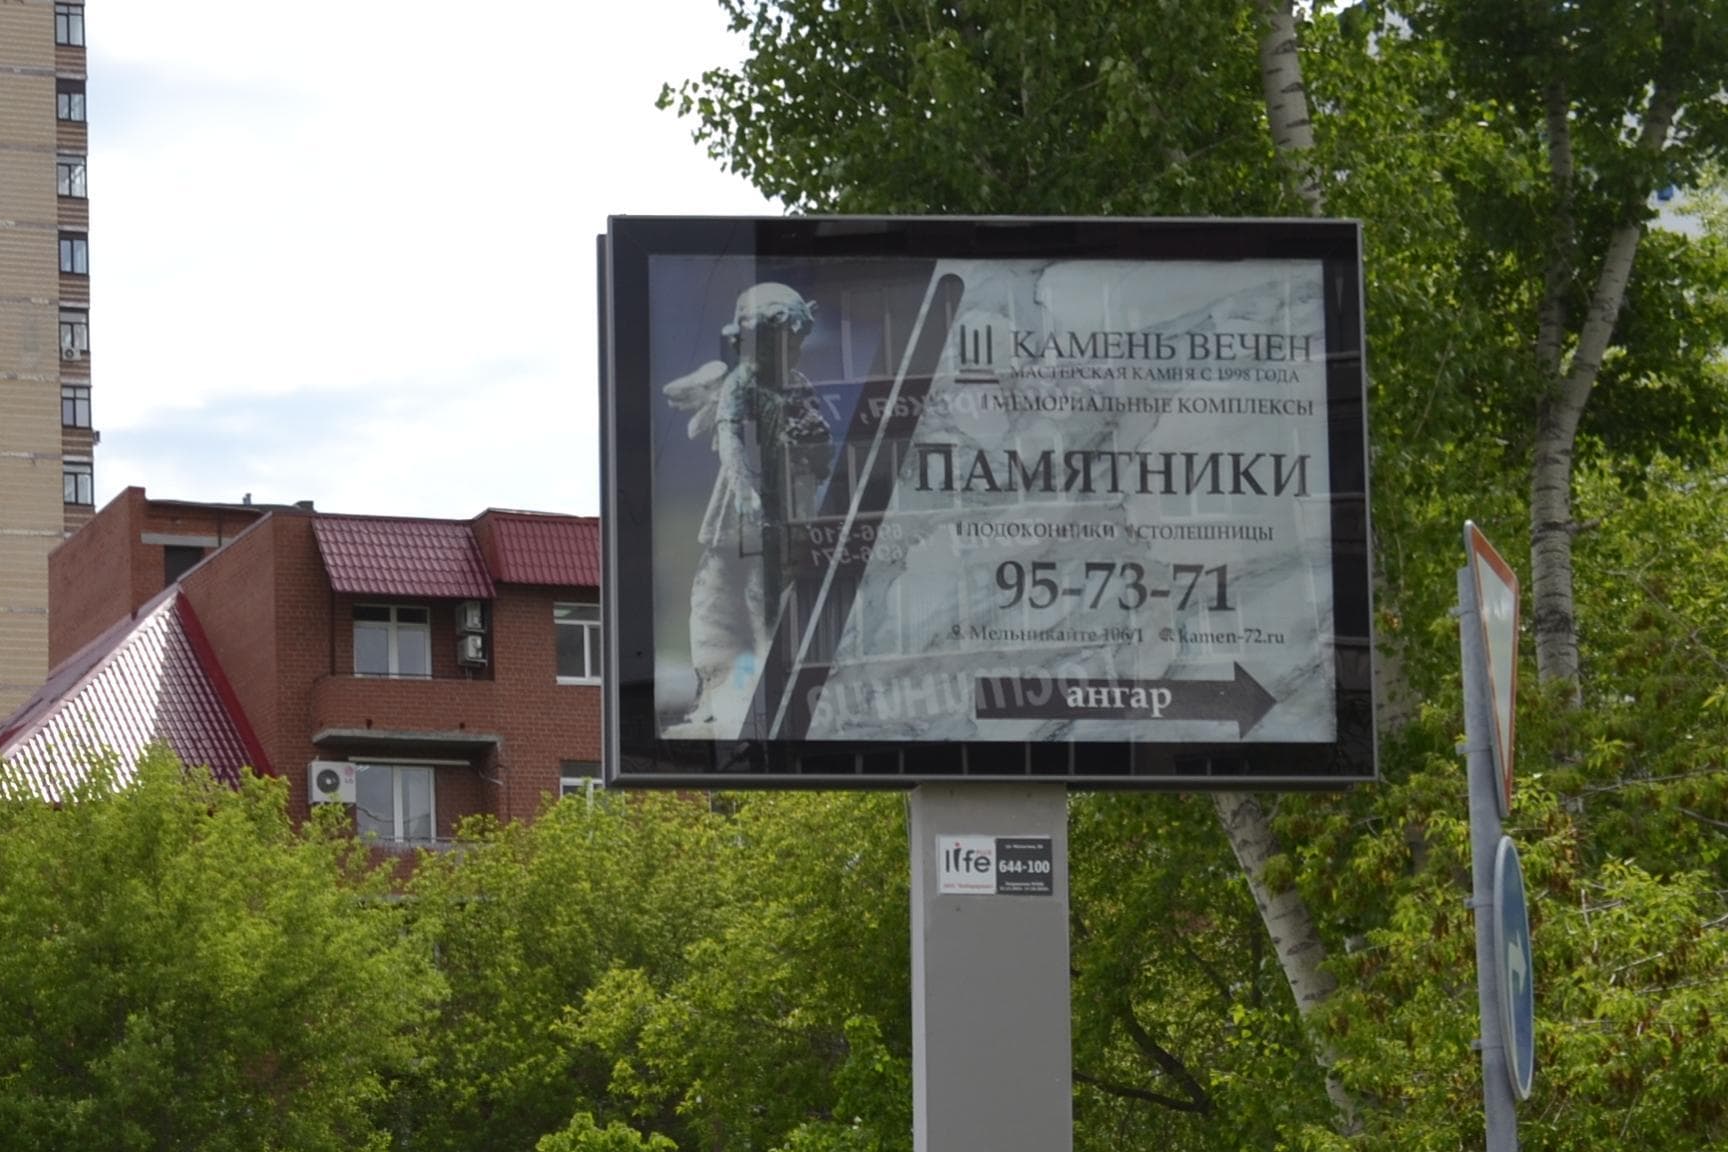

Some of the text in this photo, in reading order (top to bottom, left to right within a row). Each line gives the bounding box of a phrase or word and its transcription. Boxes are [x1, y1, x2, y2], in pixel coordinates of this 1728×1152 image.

[1010, 330, 1312, 362] КАМЕНЬ ВЕЧЕН
[1009, 366, 1300, 384] МАСТЕРСКАЯ КАМНЯ С 1998 ГОДА
[1178, 397, 1314, 417] КОМПЛЕКСЫ
[913, 443, 1312, 497] ПАМЯТНИКИ
[995, 560, 1236, 612] 95-73-71
[1178, 624, 1285, 645] kamen-72.ru
[1066, 684, 1173, 718] ангар
[945, 841, 991, 874] life
[999, 860, 1050, 873] 644-100
